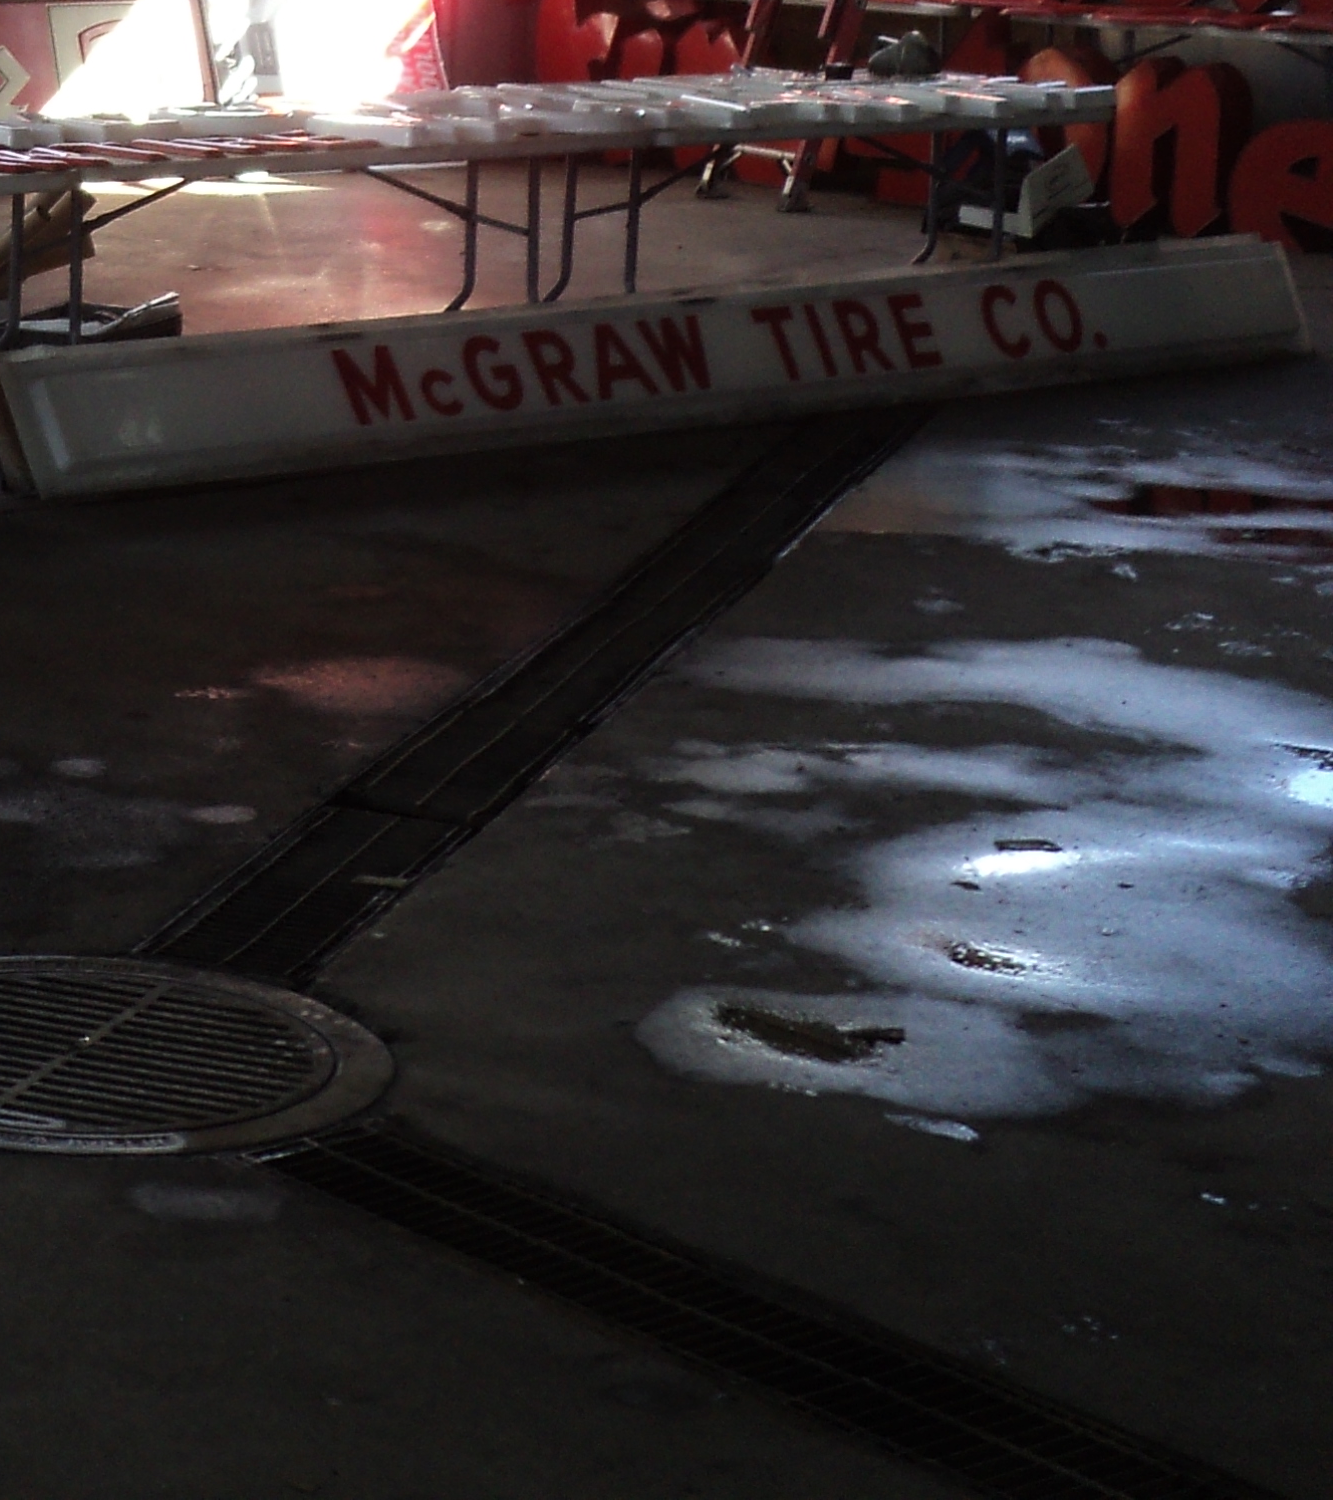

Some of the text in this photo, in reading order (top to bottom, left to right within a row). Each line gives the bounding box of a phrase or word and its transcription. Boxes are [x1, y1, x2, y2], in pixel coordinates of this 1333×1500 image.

[333, 278, 1108, 426] McGRAW TIRE CO.
